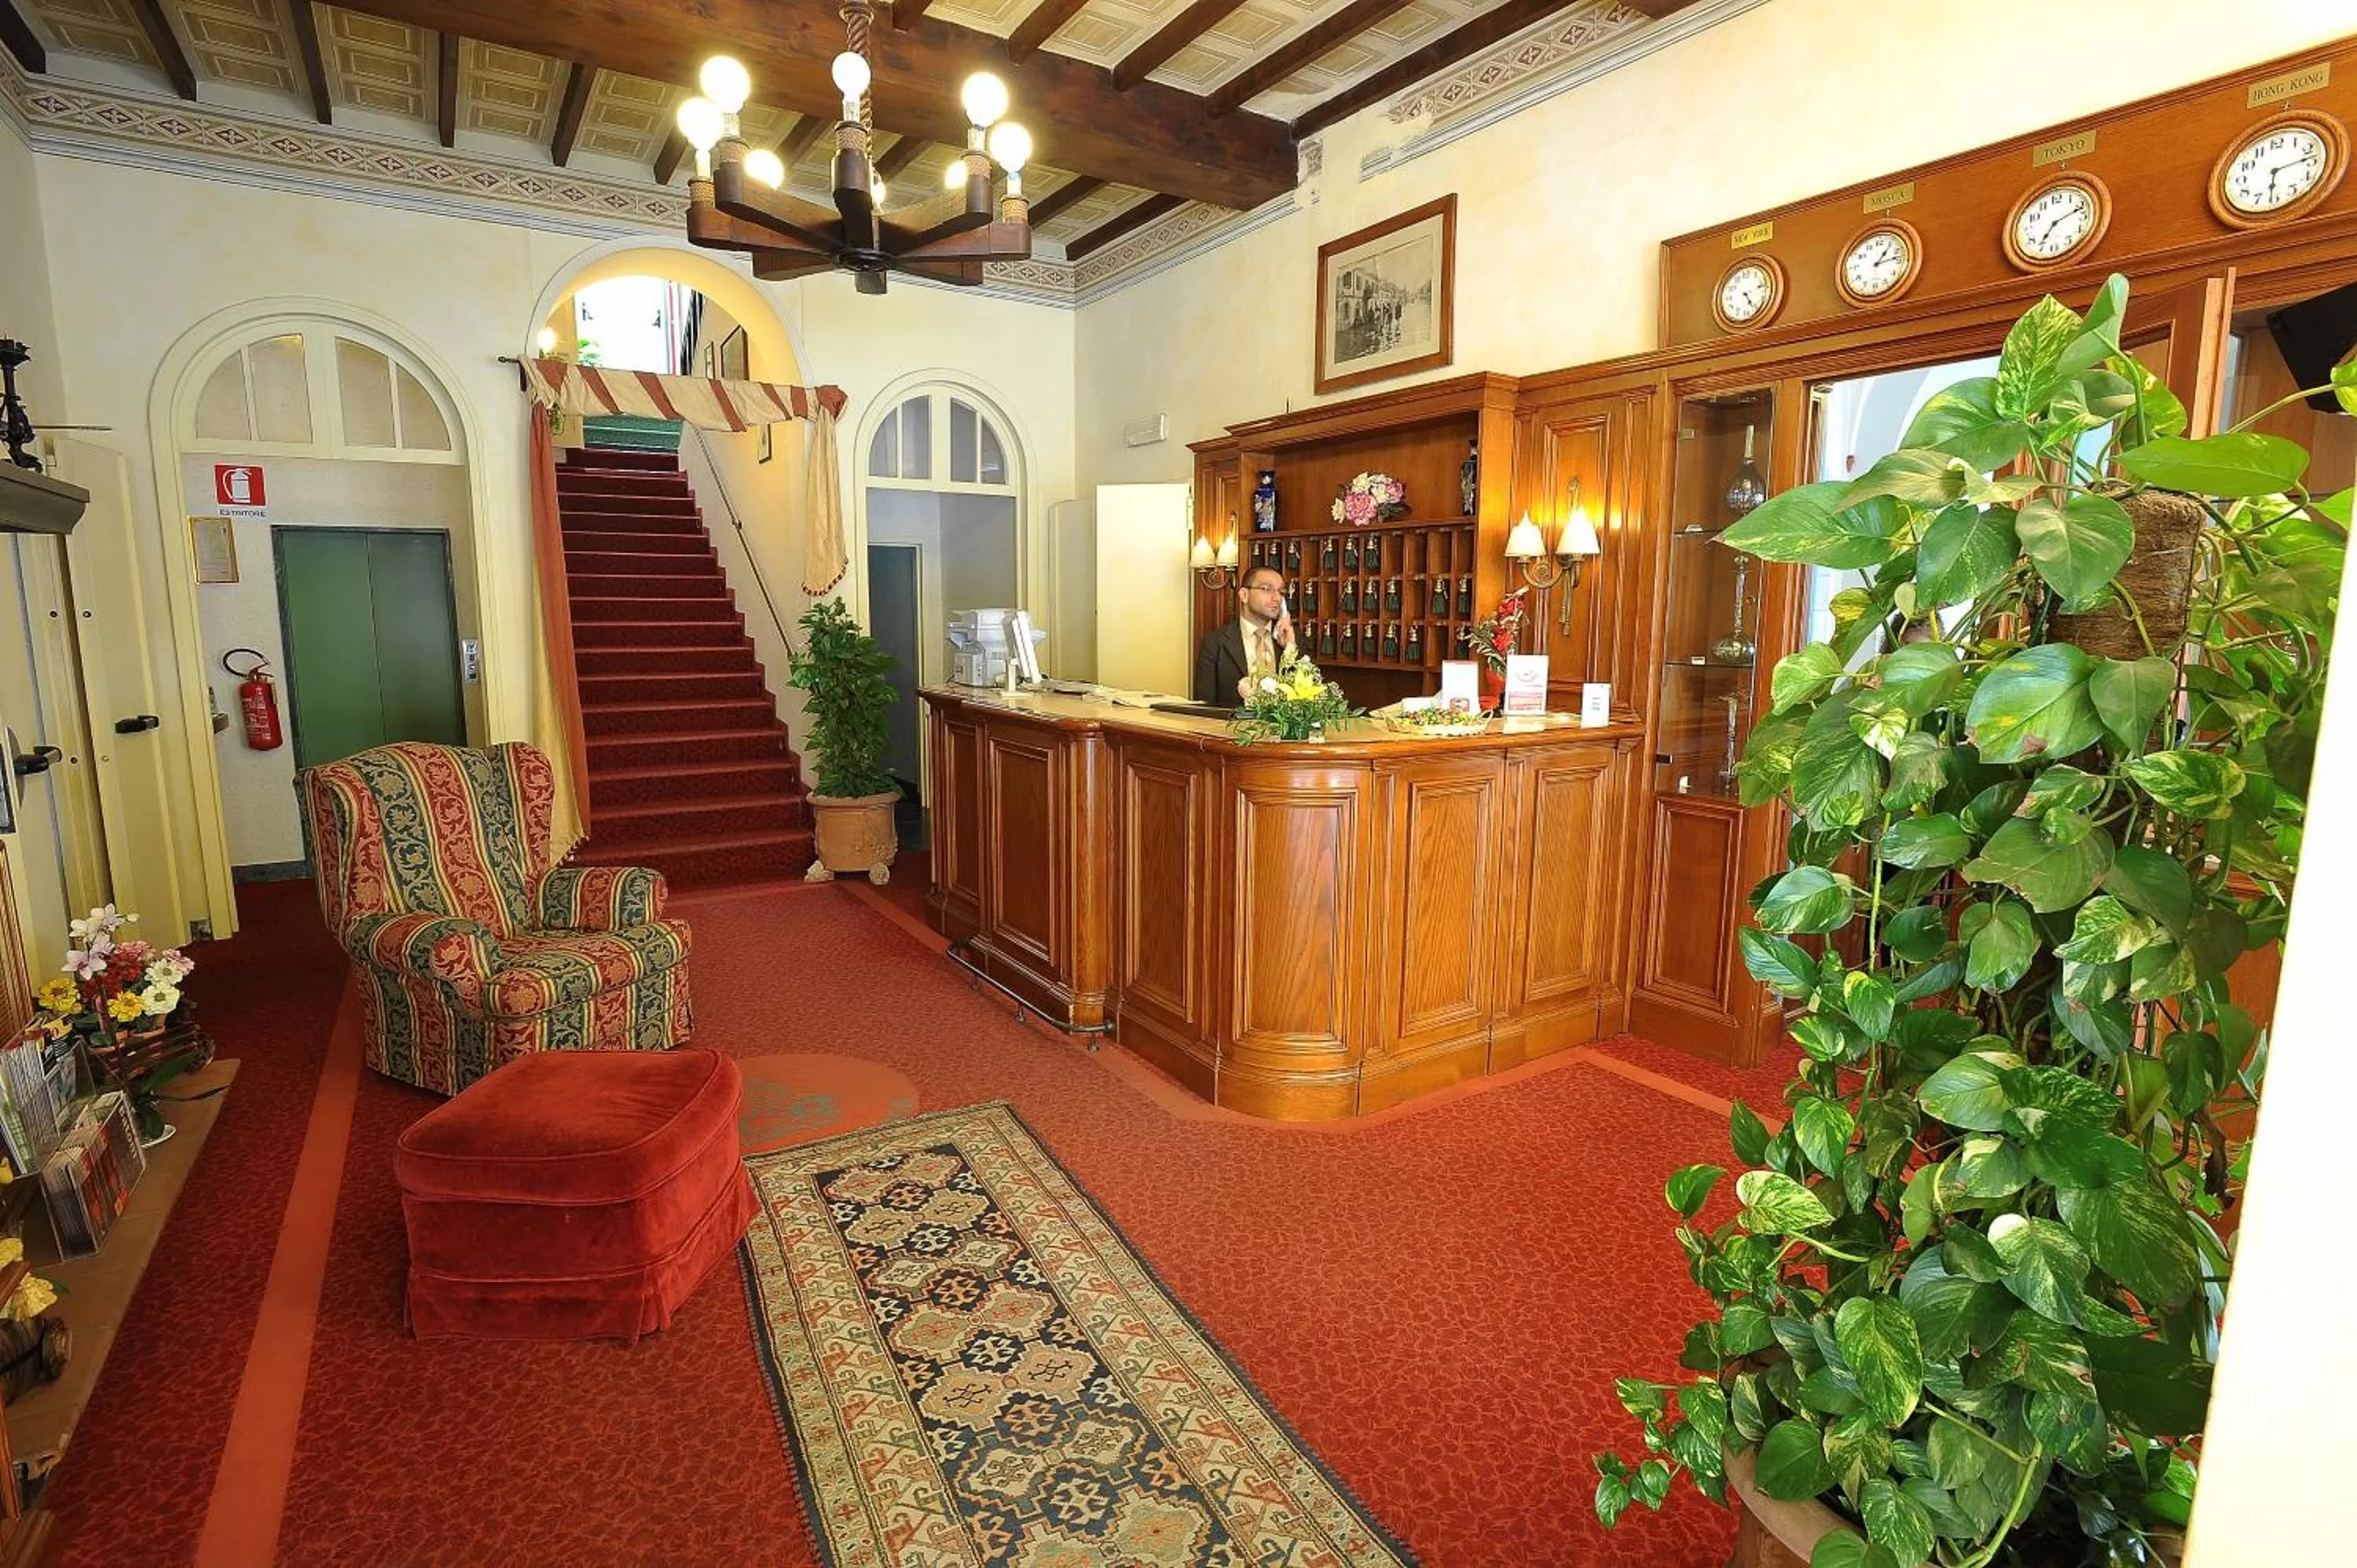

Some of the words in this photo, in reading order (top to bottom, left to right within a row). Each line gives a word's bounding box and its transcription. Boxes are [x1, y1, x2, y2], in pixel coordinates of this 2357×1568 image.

[2253, 83, 2284, 101] HONG
[2289, 71, 2323, 90] KONG
[2043, 139, 2084, 158] TOKYO
[219, 508, 267, 518] ESTINTORE
